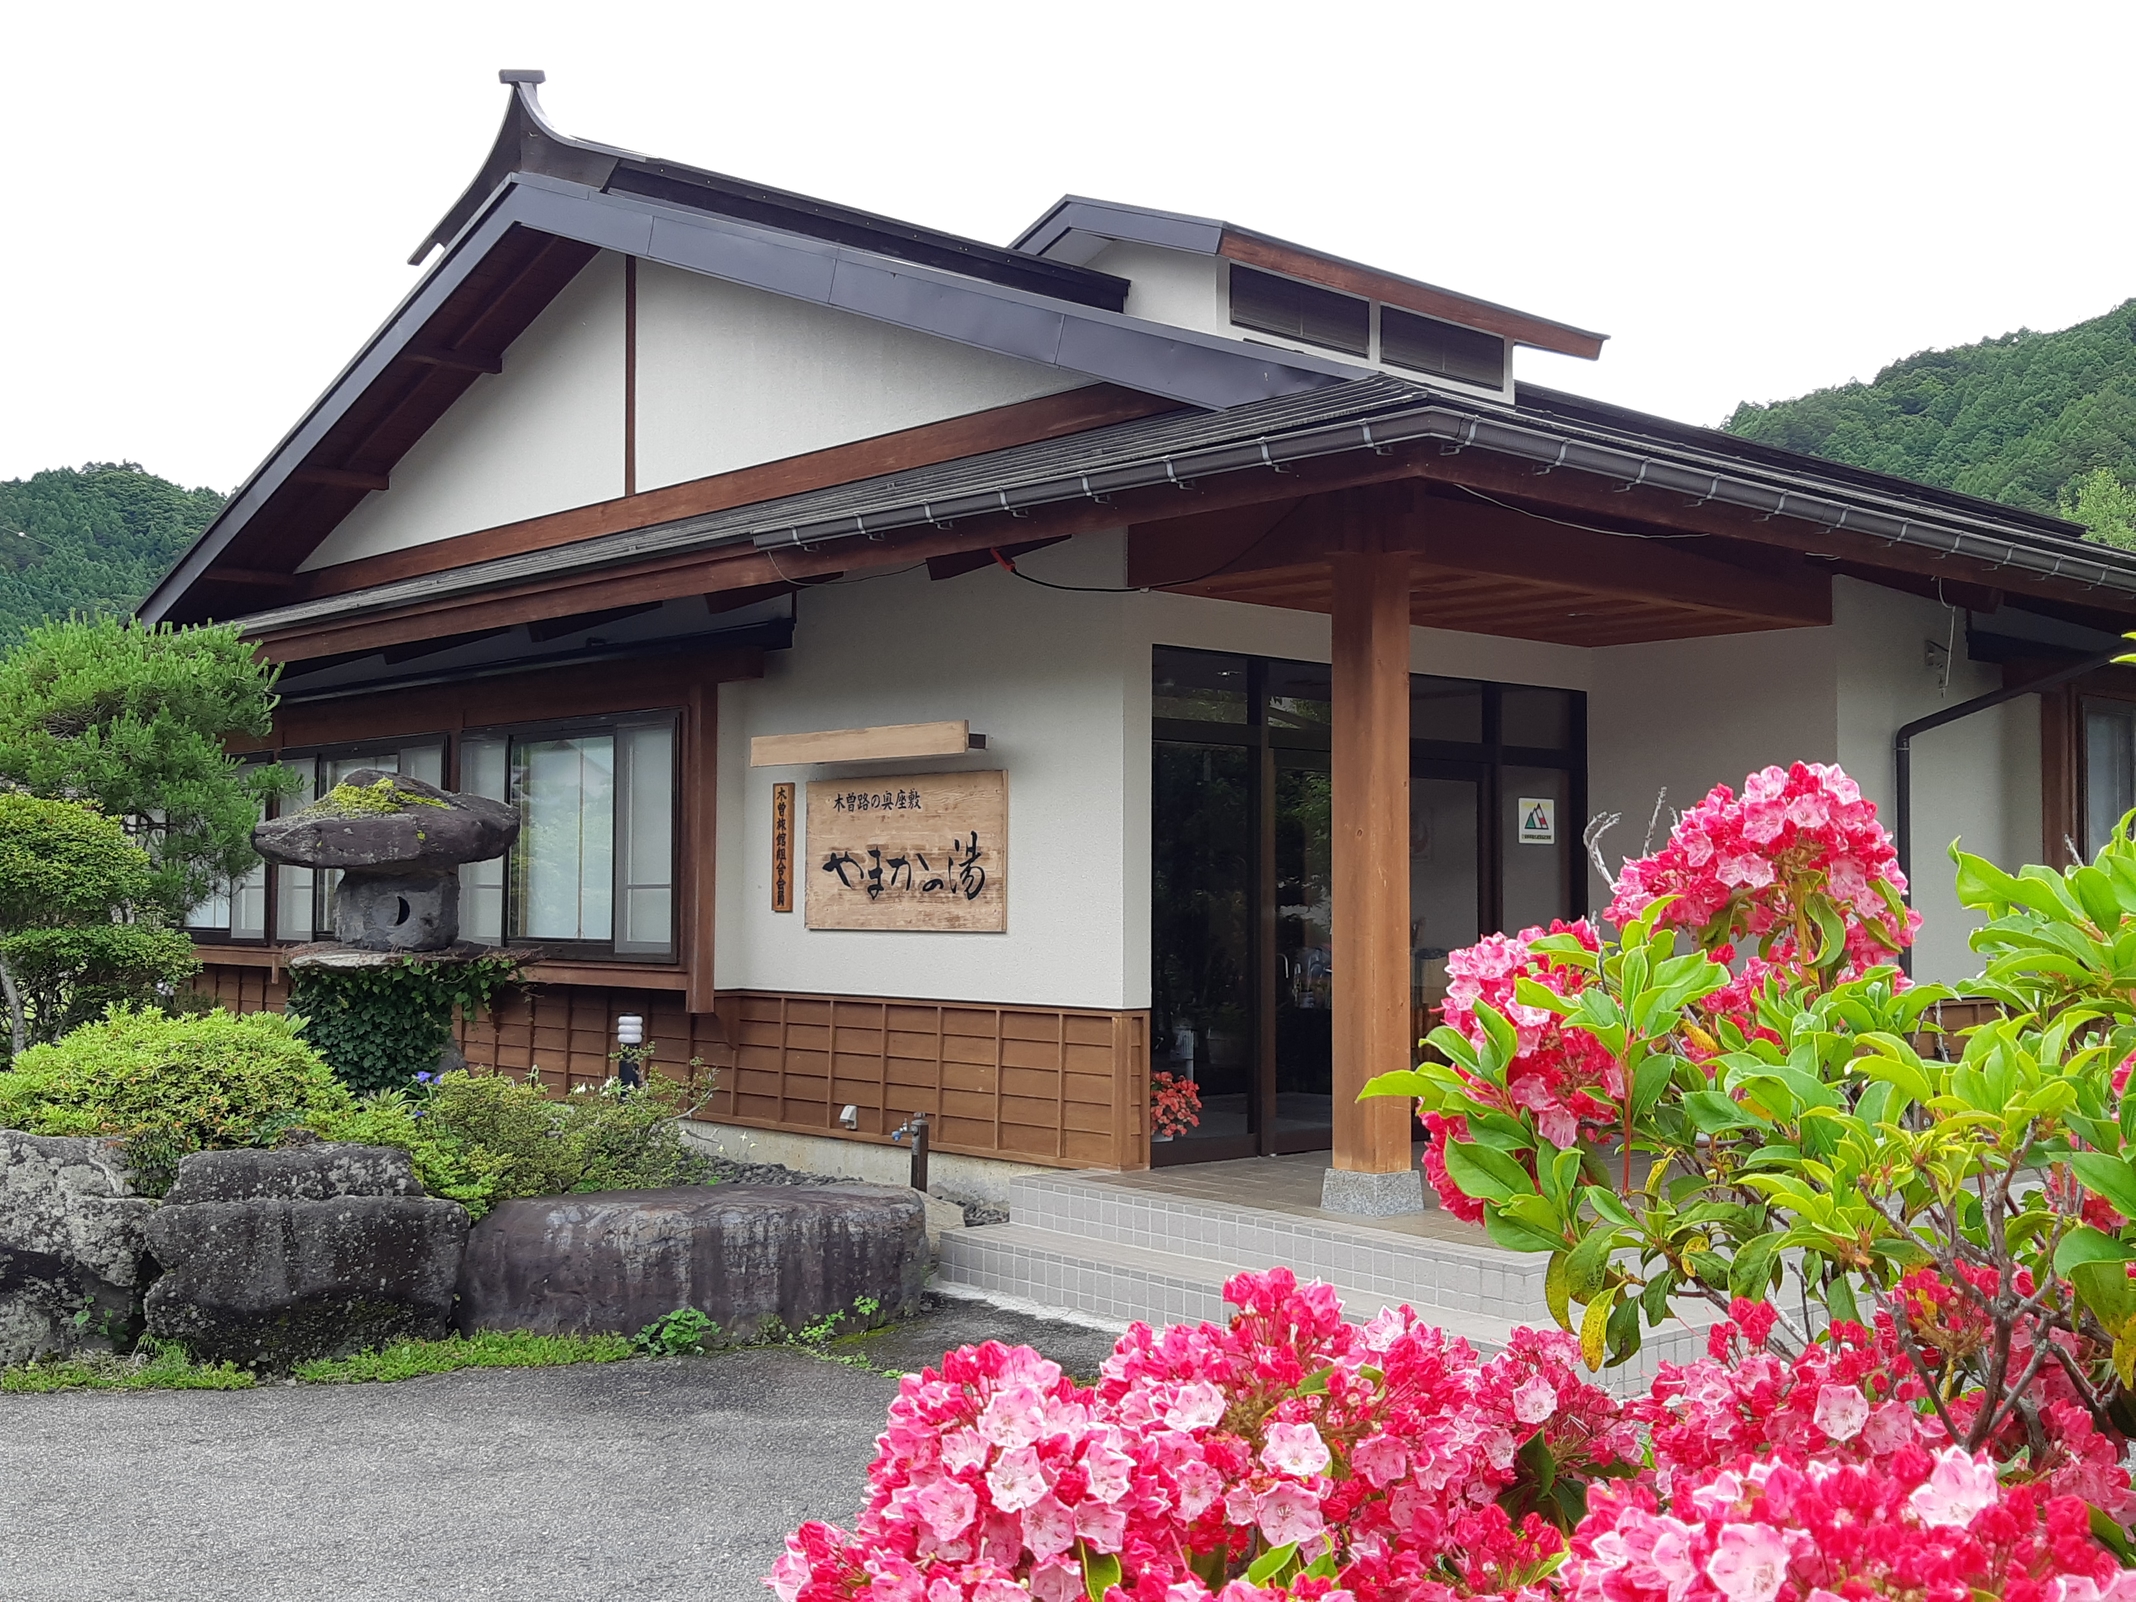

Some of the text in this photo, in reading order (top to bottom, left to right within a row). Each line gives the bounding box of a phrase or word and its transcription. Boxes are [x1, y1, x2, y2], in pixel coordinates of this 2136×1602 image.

[833, 787, 922, 813] 木曽路の奥座敷
[822, 830, 986, 900] やまかの湯
